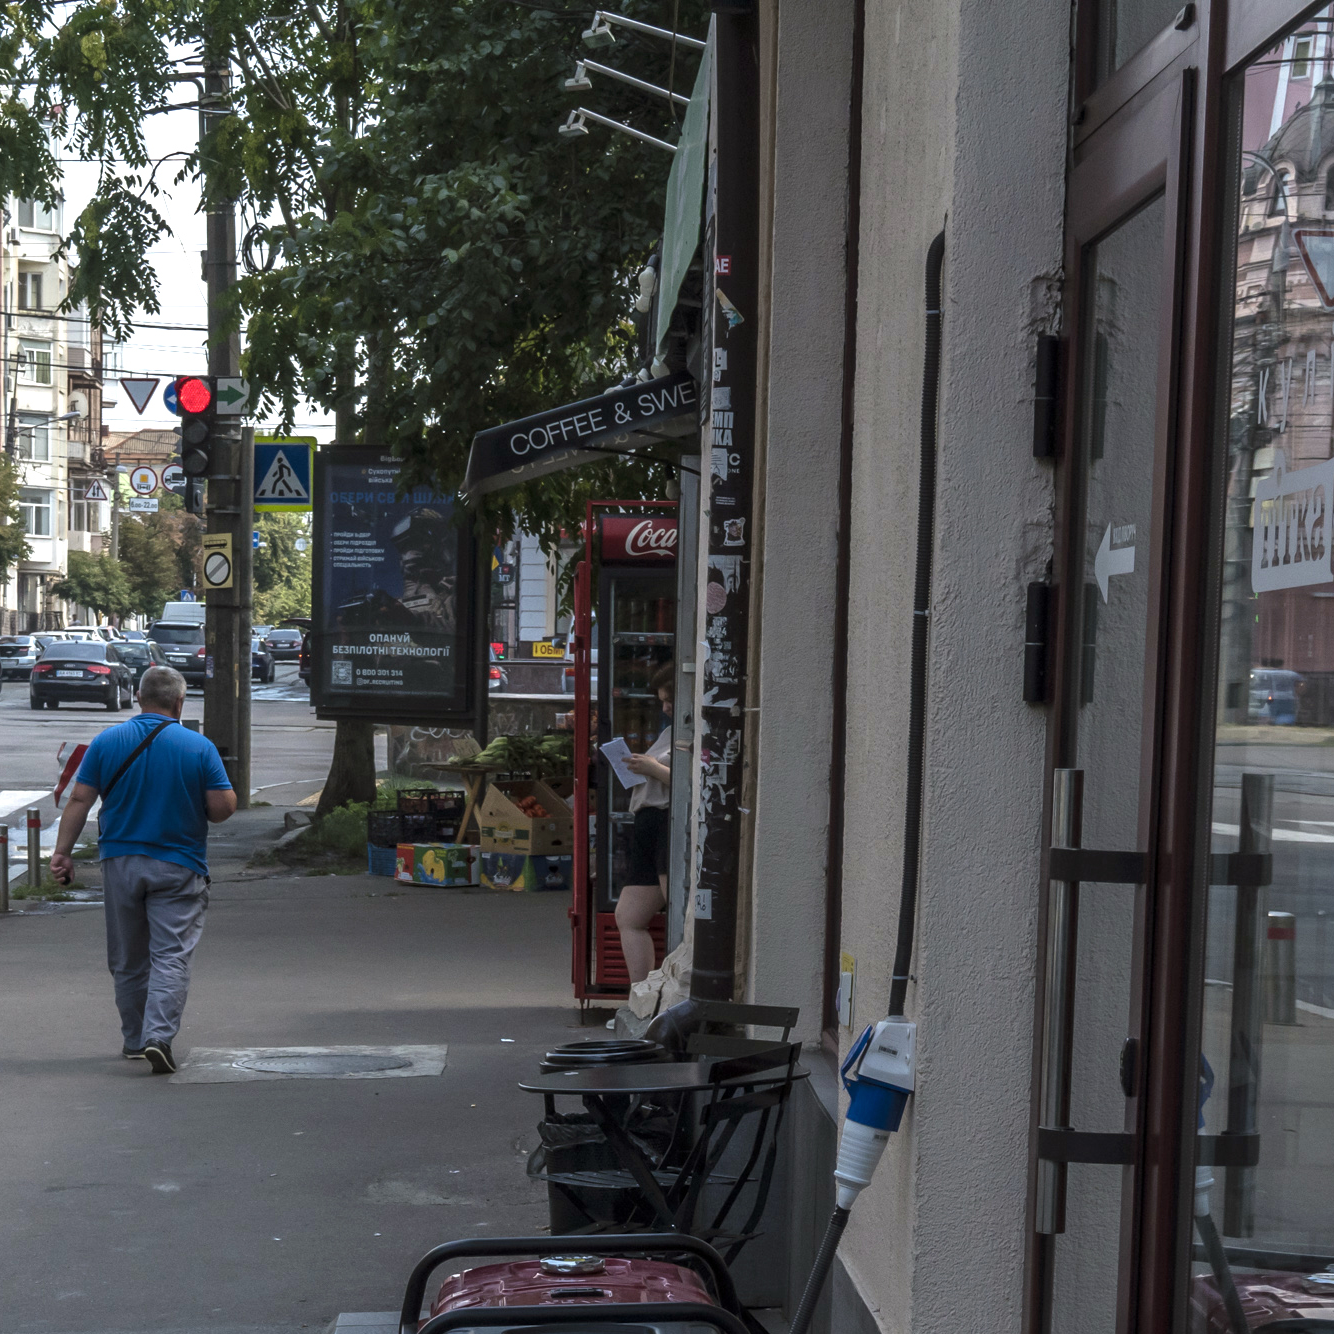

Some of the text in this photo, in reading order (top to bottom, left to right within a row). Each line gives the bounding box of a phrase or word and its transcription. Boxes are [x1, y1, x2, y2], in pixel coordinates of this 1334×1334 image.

[510, 408, 607, 455] COFFEE
[614, 402, 633, 424] &
[637, 382, 697, 416] SWE
[330, 492, 374, 503] ОБЕРИ
[369, 632, 411, 643] ОПАНУЙ
[332, 645, 451, 656] БЕЗПІЛОТНІ ТЕХНОЛОГІЇ
